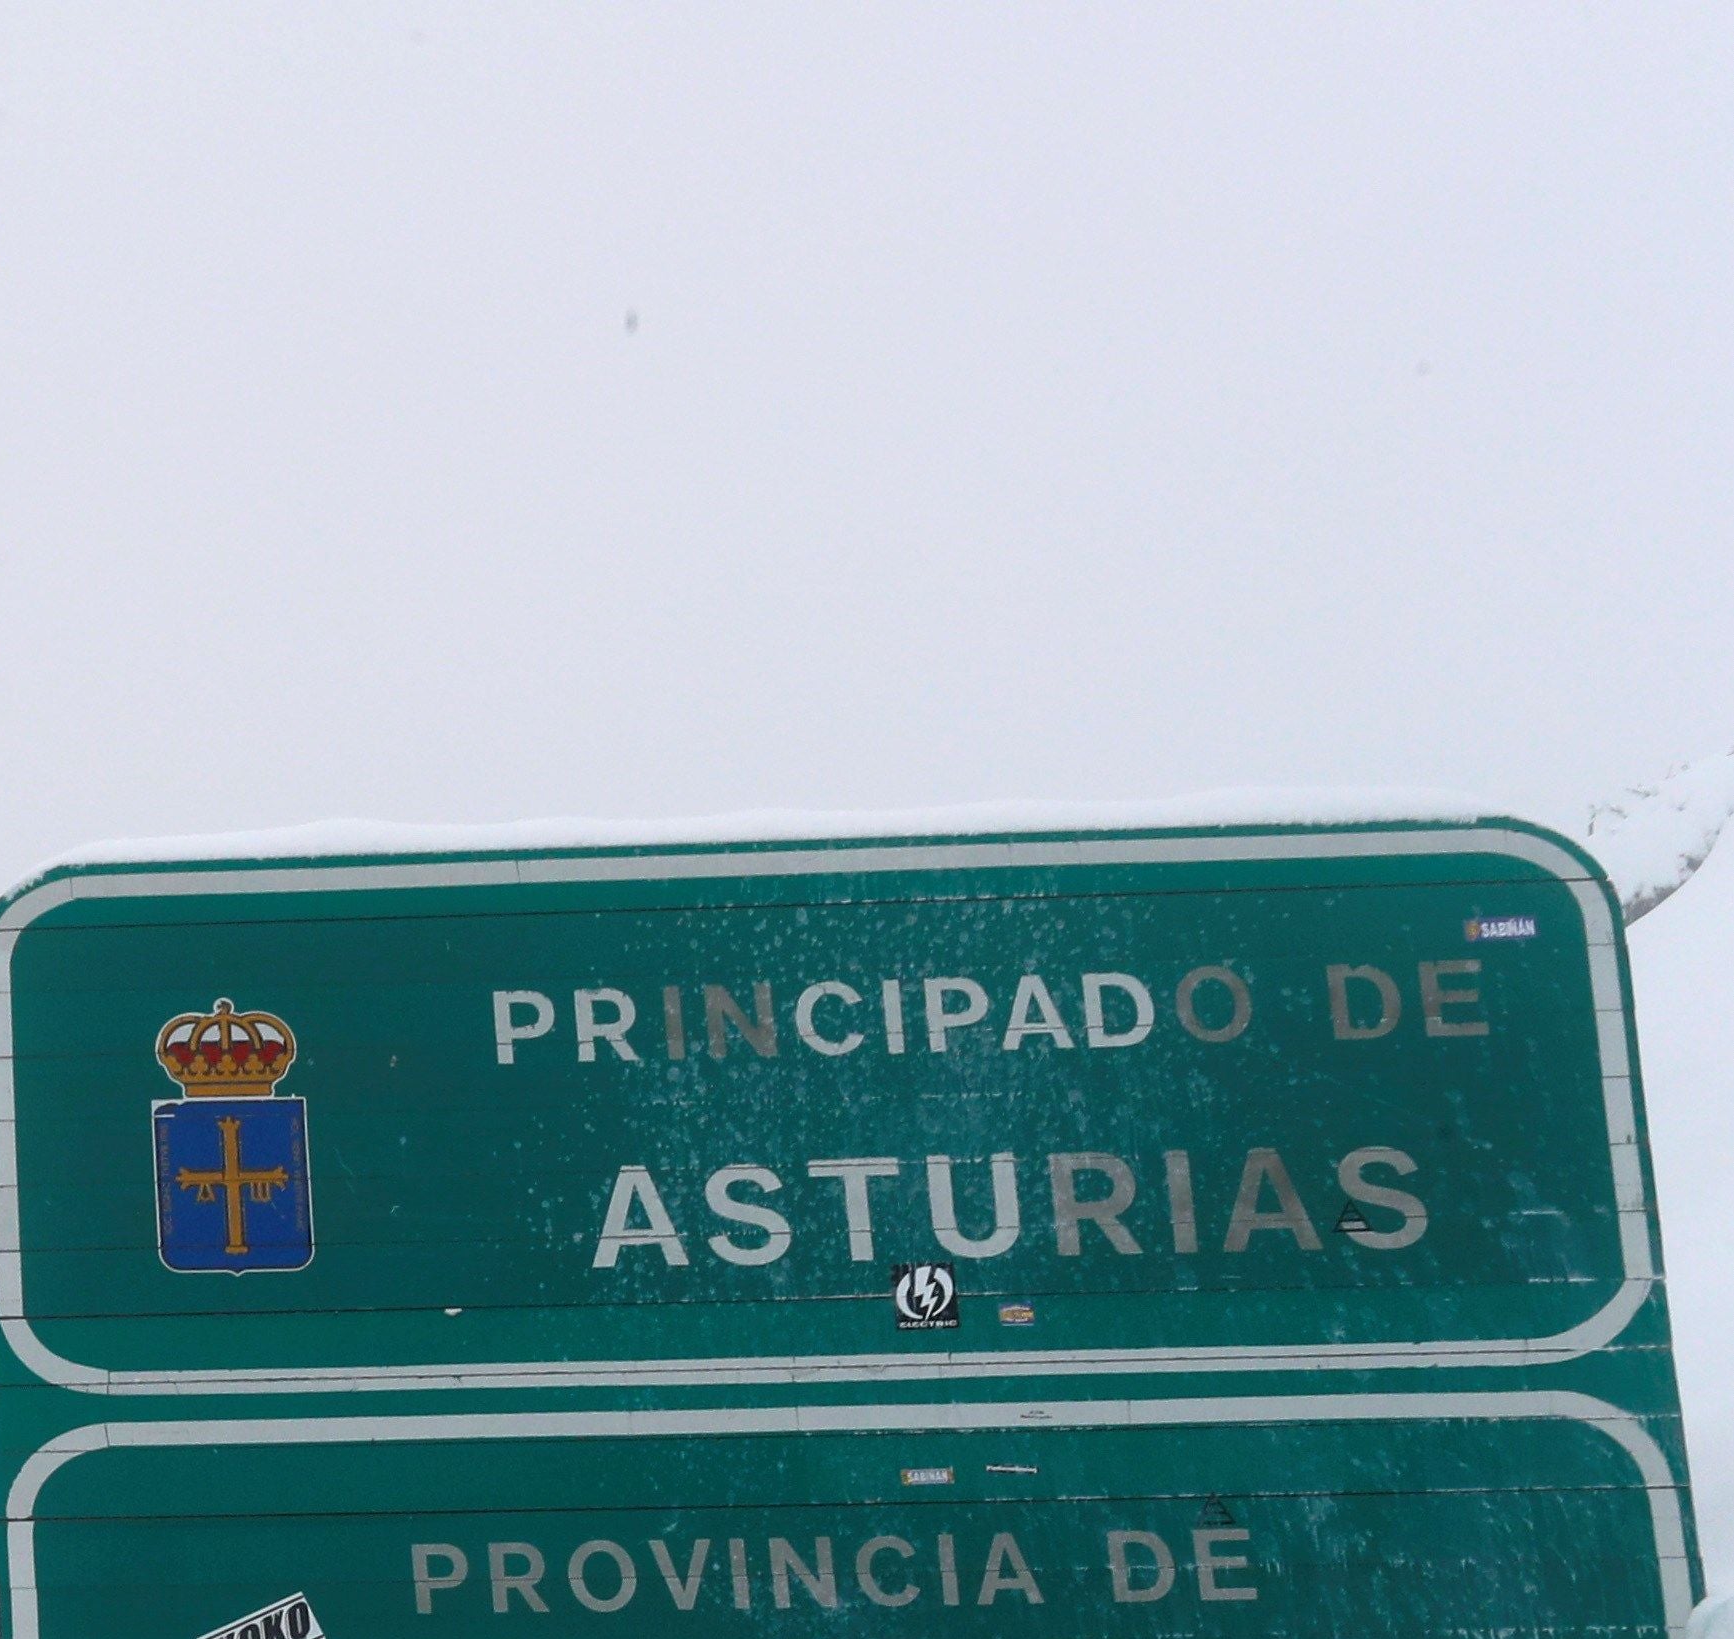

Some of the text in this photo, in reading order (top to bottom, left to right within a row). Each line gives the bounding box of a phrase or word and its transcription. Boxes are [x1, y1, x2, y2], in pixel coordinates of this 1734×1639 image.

[493, 958, 1491, 1066] PRINCIPADO DE
[592, 1145, 1430, 1268] ASTURIAS
[898, 1319, 958, 1329] ELECTRIC
[411, 1528, 1260, 1615] PROVINCIA DE
